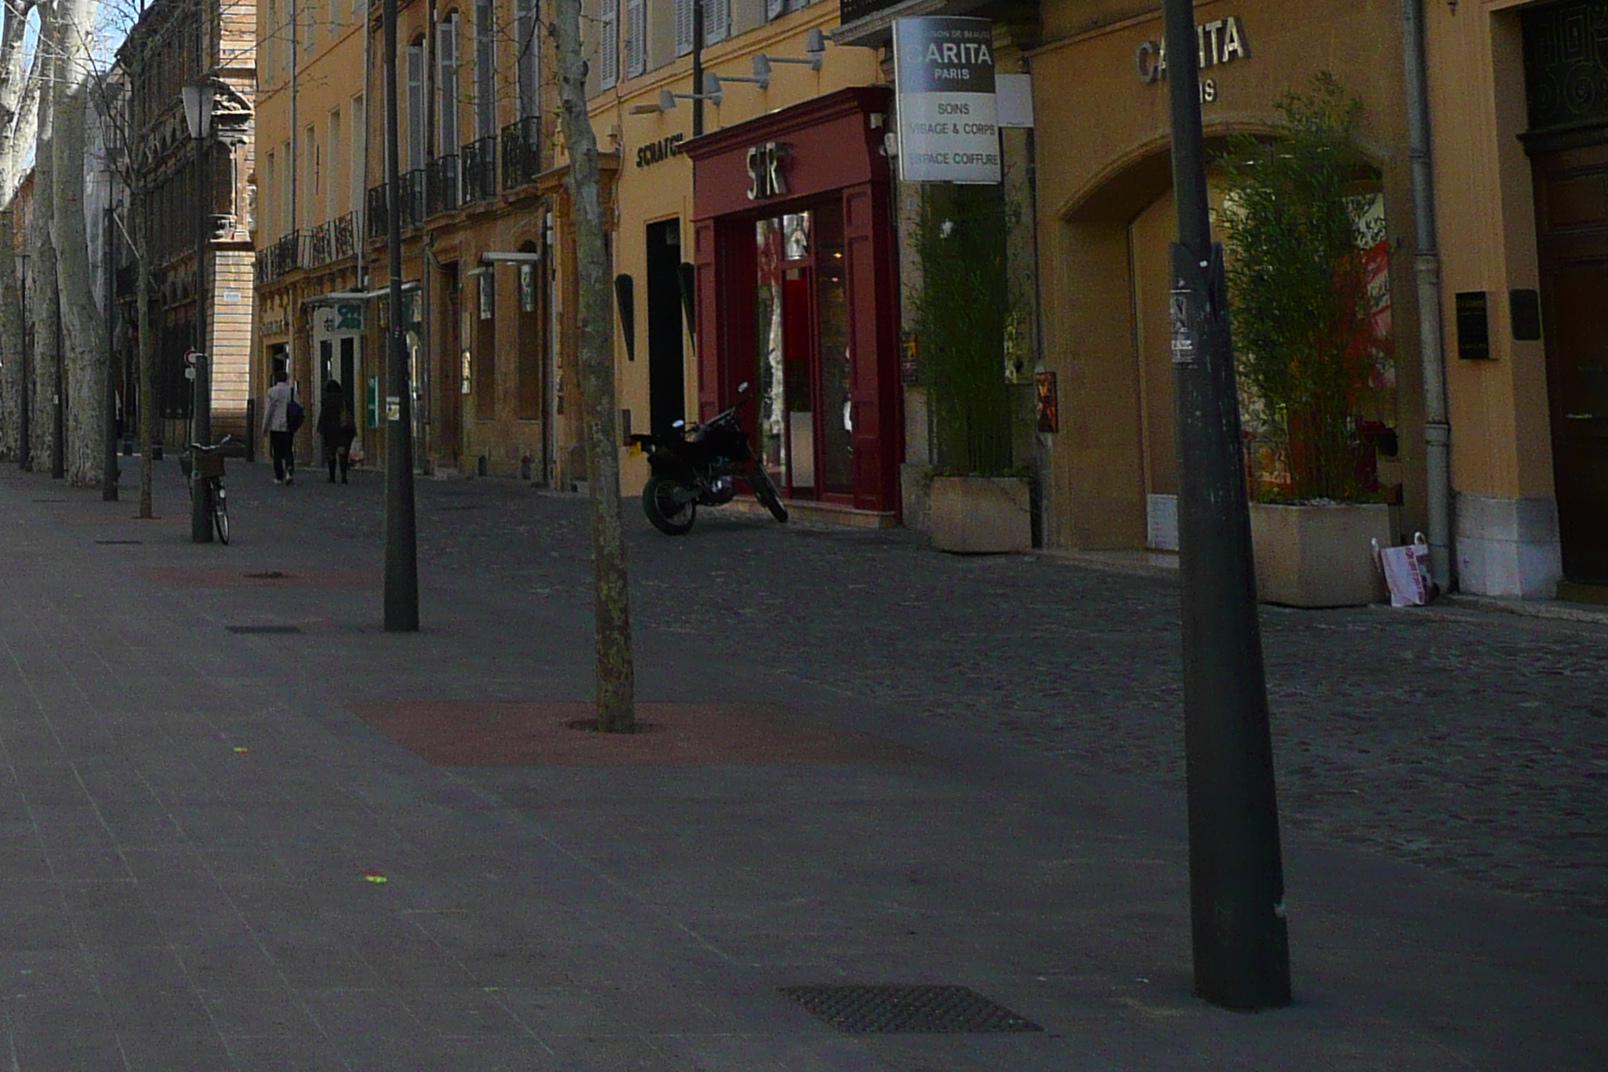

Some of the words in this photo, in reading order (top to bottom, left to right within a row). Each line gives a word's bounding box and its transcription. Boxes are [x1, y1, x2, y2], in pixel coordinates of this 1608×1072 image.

[1136, 16, 1246, 84] CITA
[935, 69, 970, 80] PARIS
[938, 103, 970, 115] SOINS
[910, 123, 949, 135] VISAGE
[953, 123, 960, 135] &
[963, 123, 997, 136] CORPS
[909, 152, 949, 165] ESPACE
[953, 152, 999, 166] COIFFURE
